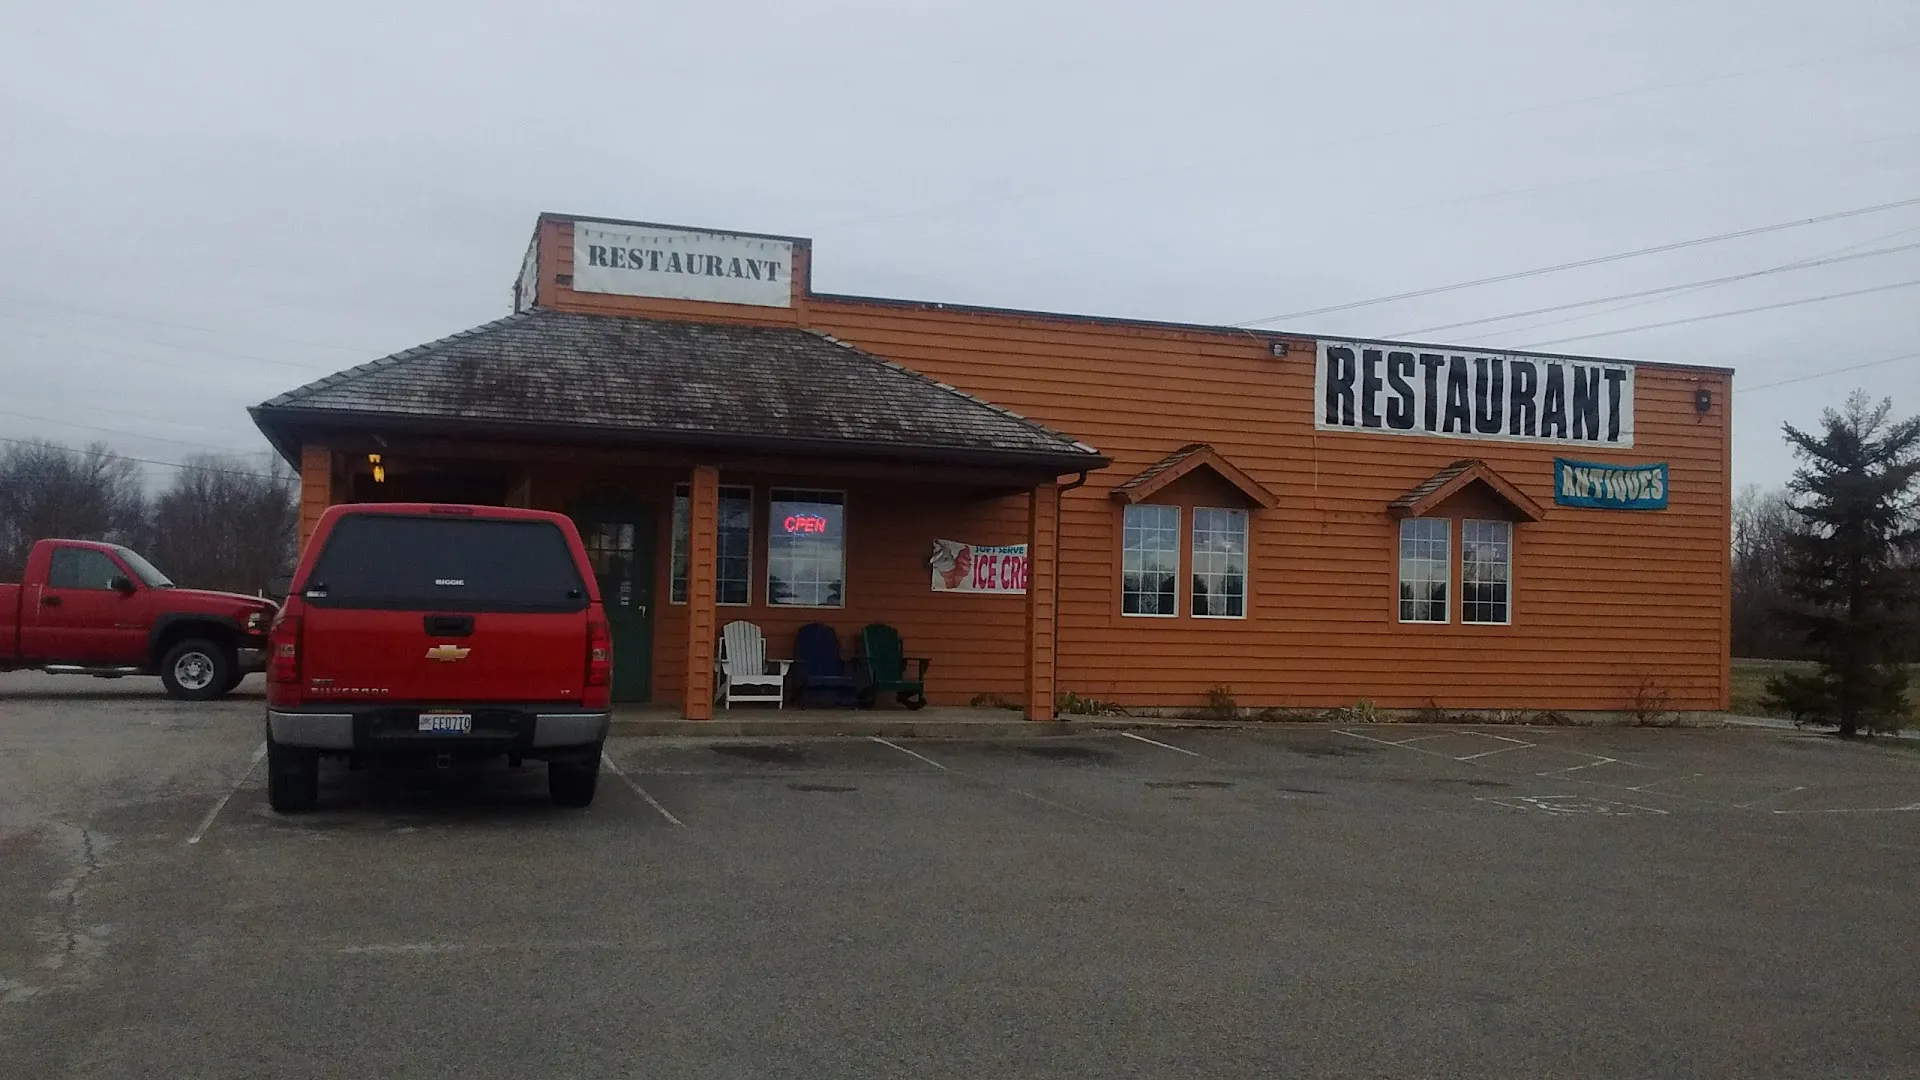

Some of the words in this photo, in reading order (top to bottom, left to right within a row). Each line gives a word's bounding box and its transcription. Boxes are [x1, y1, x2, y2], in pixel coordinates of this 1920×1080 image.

[588, 245, 781, 282] RESTAURANT
[1326, 347, 1627, 442] RESTAURANT
[1562, 464, 1664, 503] ANTIQUES
[783, 516, 827, 533] OPEN
[972, 555, 997, 589] ICE
